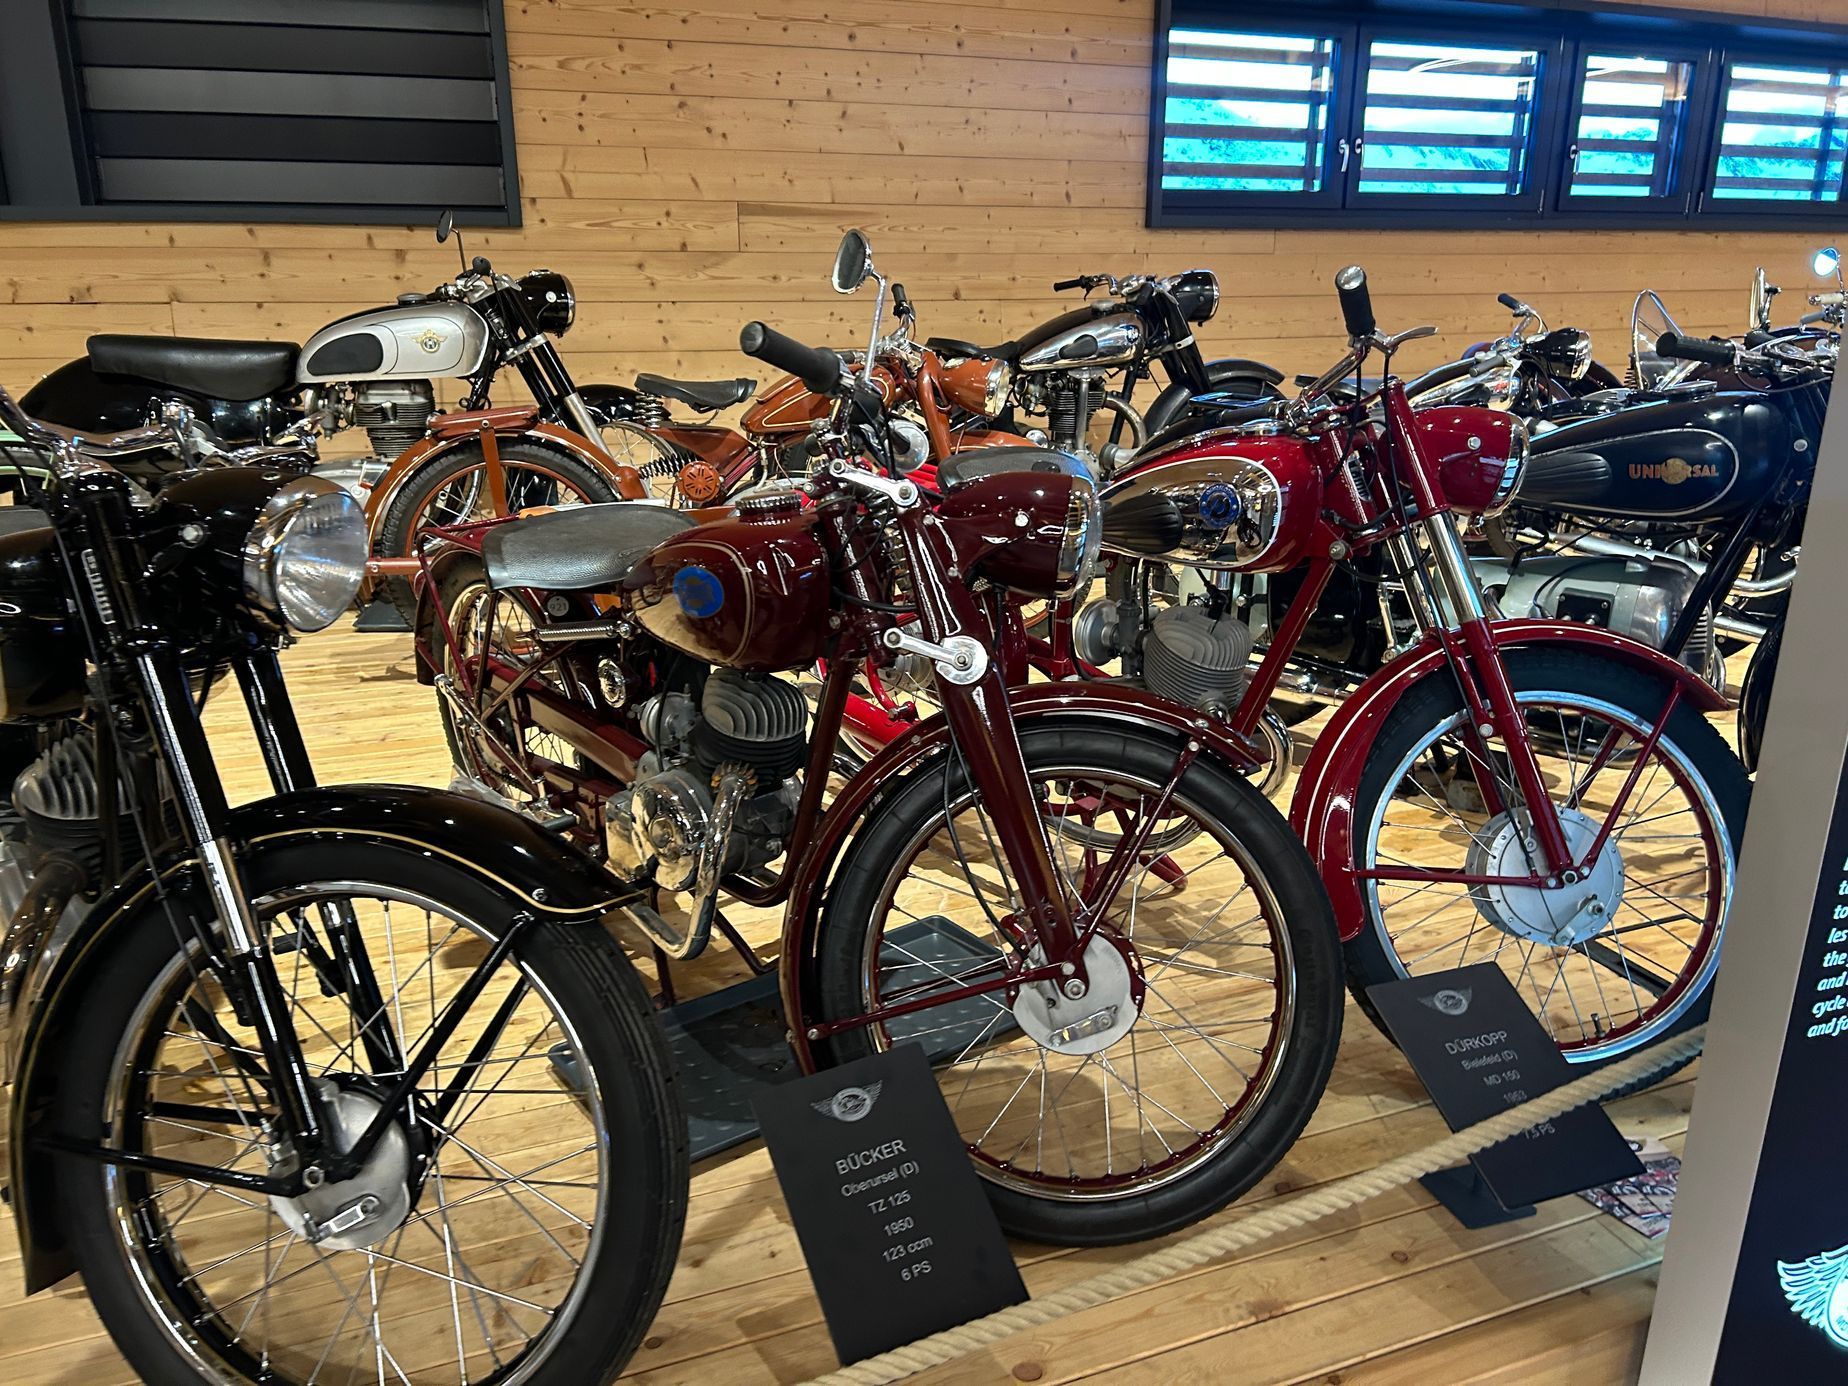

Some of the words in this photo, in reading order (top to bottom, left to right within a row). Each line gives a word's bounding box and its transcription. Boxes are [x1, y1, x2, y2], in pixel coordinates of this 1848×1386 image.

[1628, 462, 1719, 480] UNIRSAL
[1823, 950, 1847, 968] the
[1817, 971, 1847, 991] and
[1811, 994, 1847, 1018] cycle
[1807, 1017, 1837, 1038] and
[1501, 1049, 1518, 1062] (D)
[1483, 1074, 1501, 1086] MD
[1502, 1069, 1520, 1081] 150
[1538, 1123, 1555, 1136] PS
[835, 1139, 906, 1175] BÜCKER
[841, 1167, 898, 1197] Oberursel
[899, 1160, 920, 1178] (D)
[867, 1198, 887, 1215] TZ
[888, 1190, 911, 1208] 125
[883, 1216, 915, 1237] 1950
[882, 1245, 907, 1263] 123
[907, 1235, 933, 1254] ccm
[901, 1267, 911, 1281] 6
[912, 1260, 932, 1278] PS
